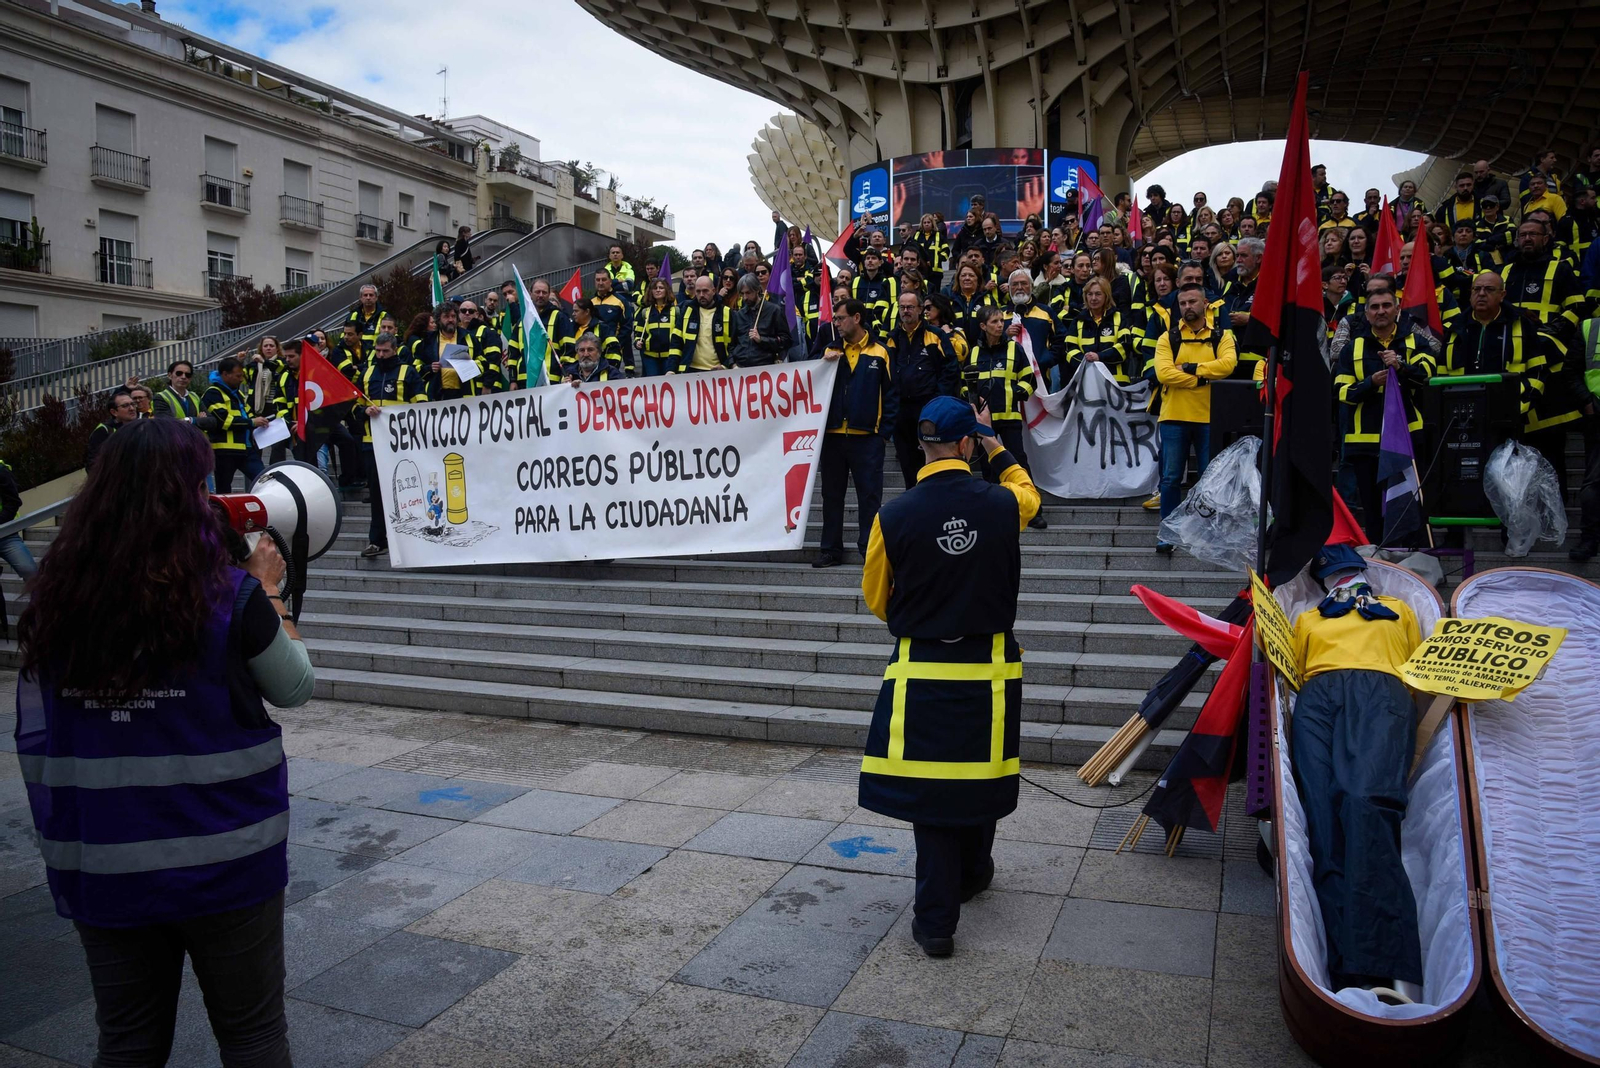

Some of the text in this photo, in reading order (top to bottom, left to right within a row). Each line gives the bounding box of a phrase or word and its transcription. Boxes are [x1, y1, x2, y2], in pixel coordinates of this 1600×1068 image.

[389, 369, 823, 453] SERVICIO POSTAL = DERECHO UNIVERSAL
[516, 440, 741, 491] CORREOS PÚBLICO
[515, 483, 748, 535] PARA LA CIUDADANÍA
[1426, 635, 1549, 659] SOMOS SERVICIO
[1442, 620, 1551, 647] Correos
[1422, 642, 1528, 671] PÚBLICO
[1427, 667, 1460, 675] esclavos
[1461, 669, 1473, 677] de
[1473, 672, 1516, 686] AMAZON,
[1433, 675, 1457, 684] TEMU,
[1459, 679, 1504, 692] ALIEXPRE
[110, 710, 131, 723] 8M
